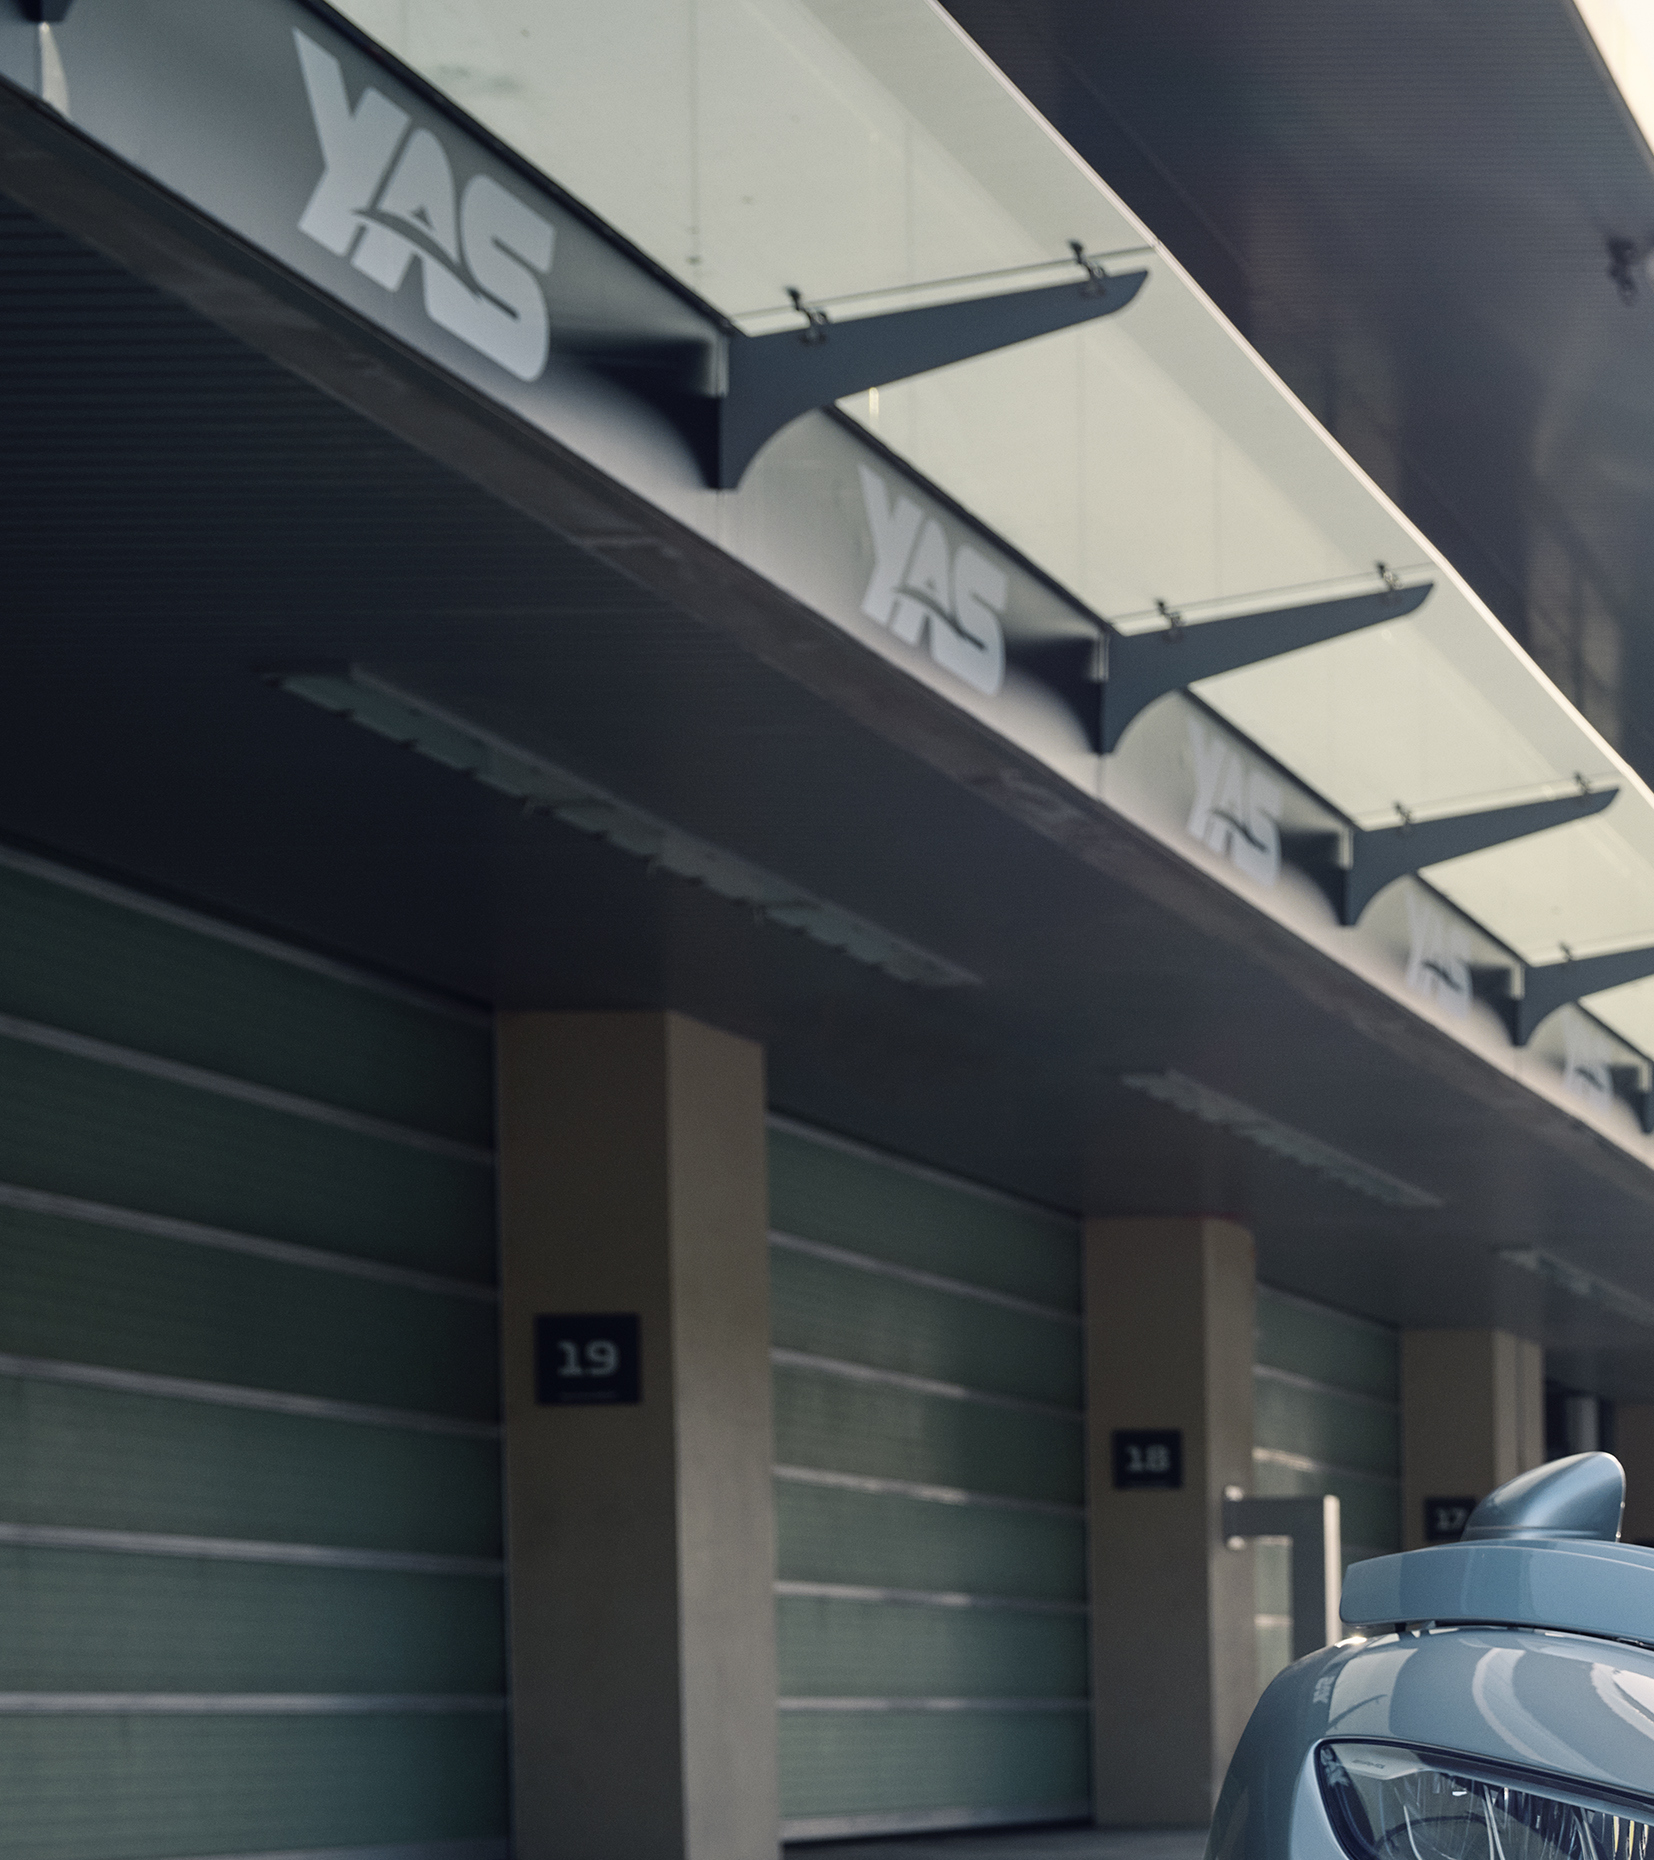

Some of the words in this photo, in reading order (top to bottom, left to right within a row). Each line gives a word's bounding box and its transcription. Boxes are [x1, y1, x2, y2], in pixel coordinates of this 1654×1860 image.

[293, 28, 556, 382] YAS
[857, 463, 1008, 696] YAS
[556, 1339, 620, 1377] 19
